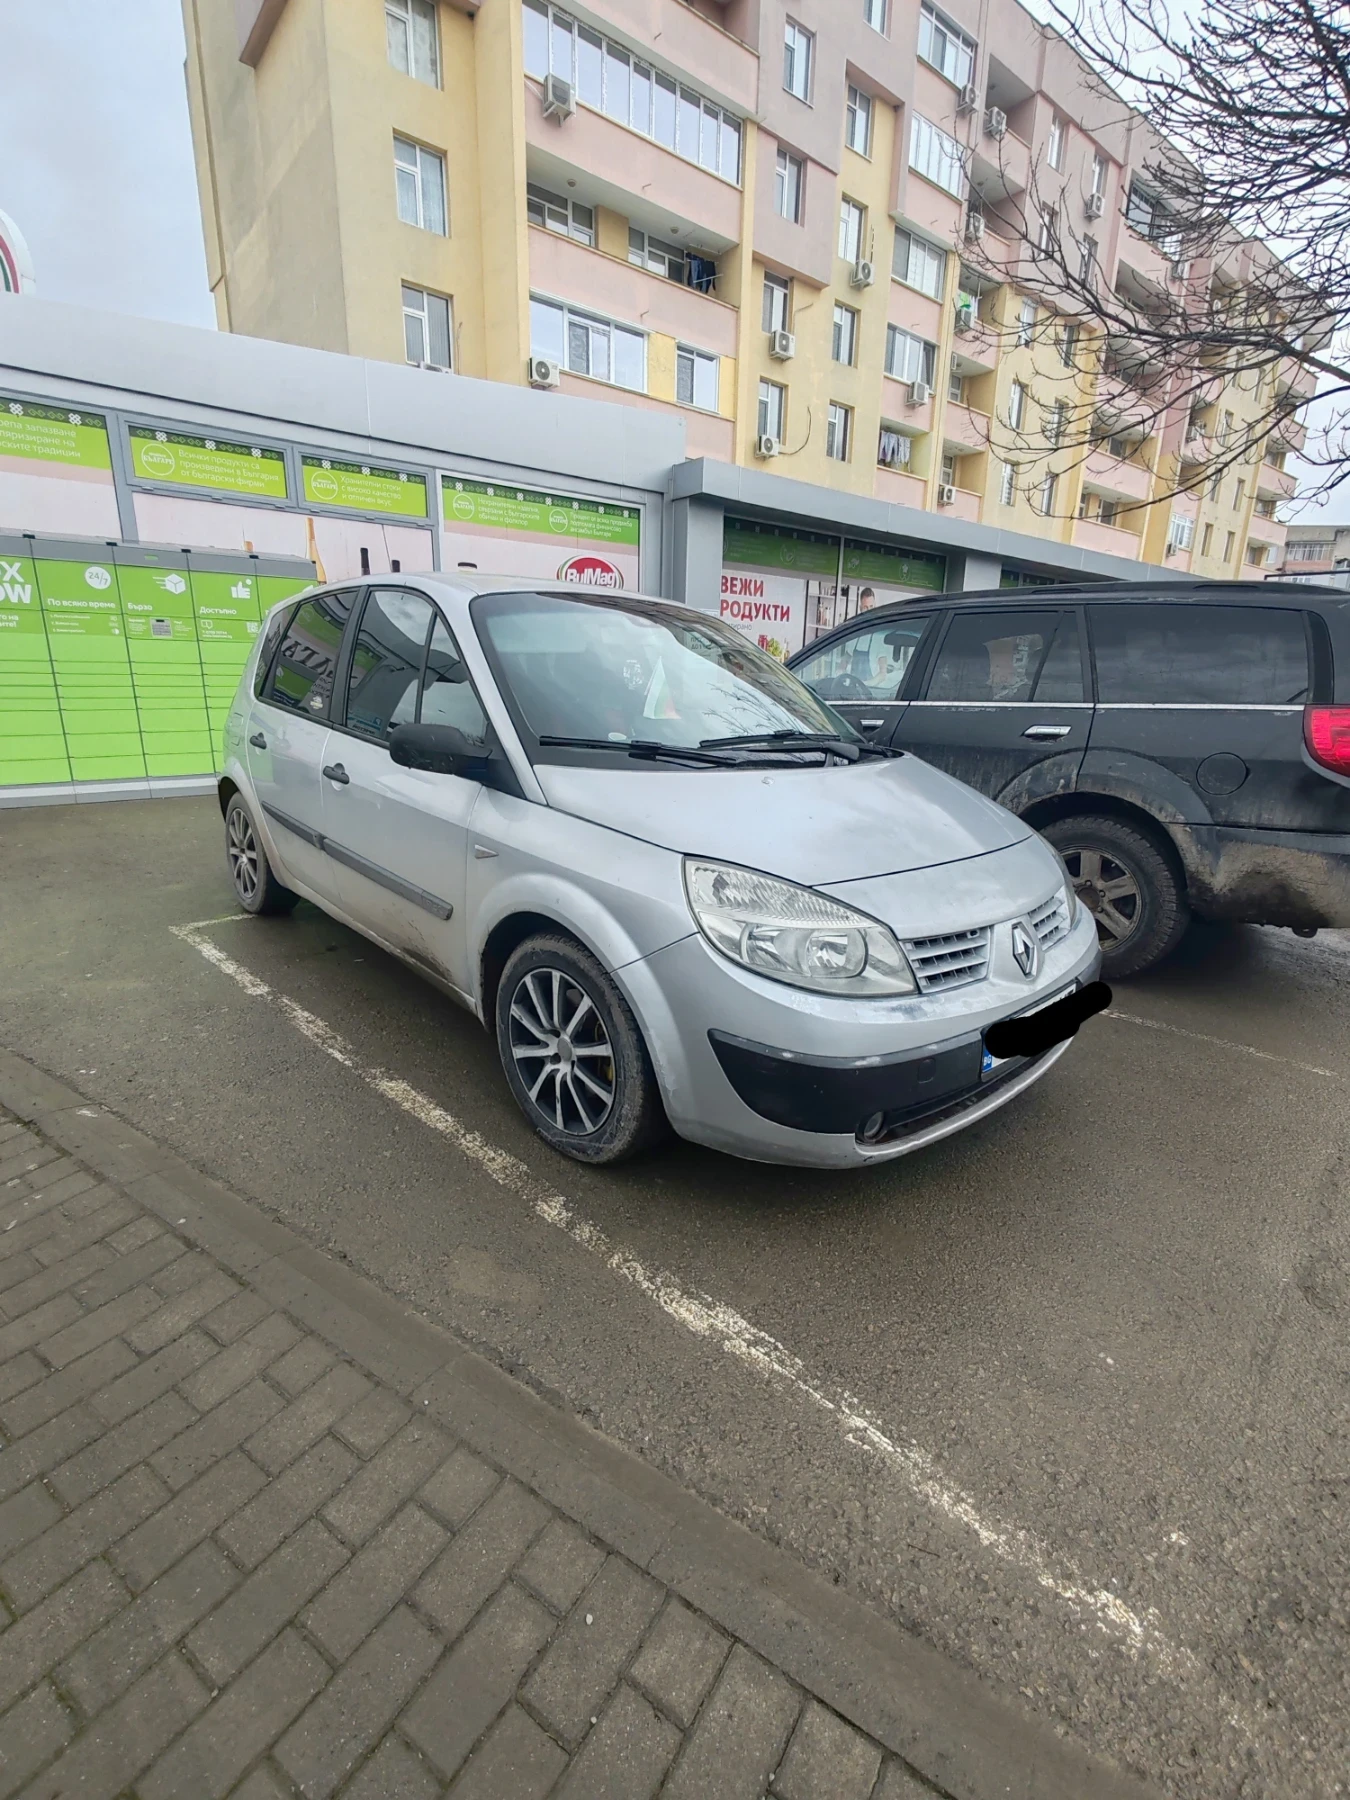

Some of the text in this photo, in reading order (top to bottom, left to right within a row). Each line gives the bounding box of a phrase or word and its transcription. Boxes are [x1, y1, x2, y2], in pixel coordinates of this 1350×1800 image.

[26, 423, 76, 438] запазване
[0, 430, 75, 448] ляризиране на
[0, 441, 81, 457] ските традиции
[178, 449, 210, 461] Всички
[211, 456, 249, 468] продукти
[180, 460, 235, 475] произведени
[243, 468, 279, 481] България
[192, 471, 235, 483] български
[236, 477, 265, 488] фирми
[340, 475, 381, 488] Хранителни
[382, 483, 401, 491] стоки
[347, 486, 371, 495] високо
[372, 490, 402, 500] качество
[348, 494, 376, 503] отличен
[377, 498, 393, 507] вкус
[504, 517, 528, 526] фолклор
[88, 571, 108, 586] 24/7
[566, 567, 616, 588] BulMag
[721, 575, 764, 598] ВЕЖИ
[47, 598, 60, 607] По
[62, 600, 88, 608] всяко
[128, 602, 153, 611] Бърза
[200, 606, 237, 615] Достъпно
[720, 599, 790, 622] РОДУКТИ
